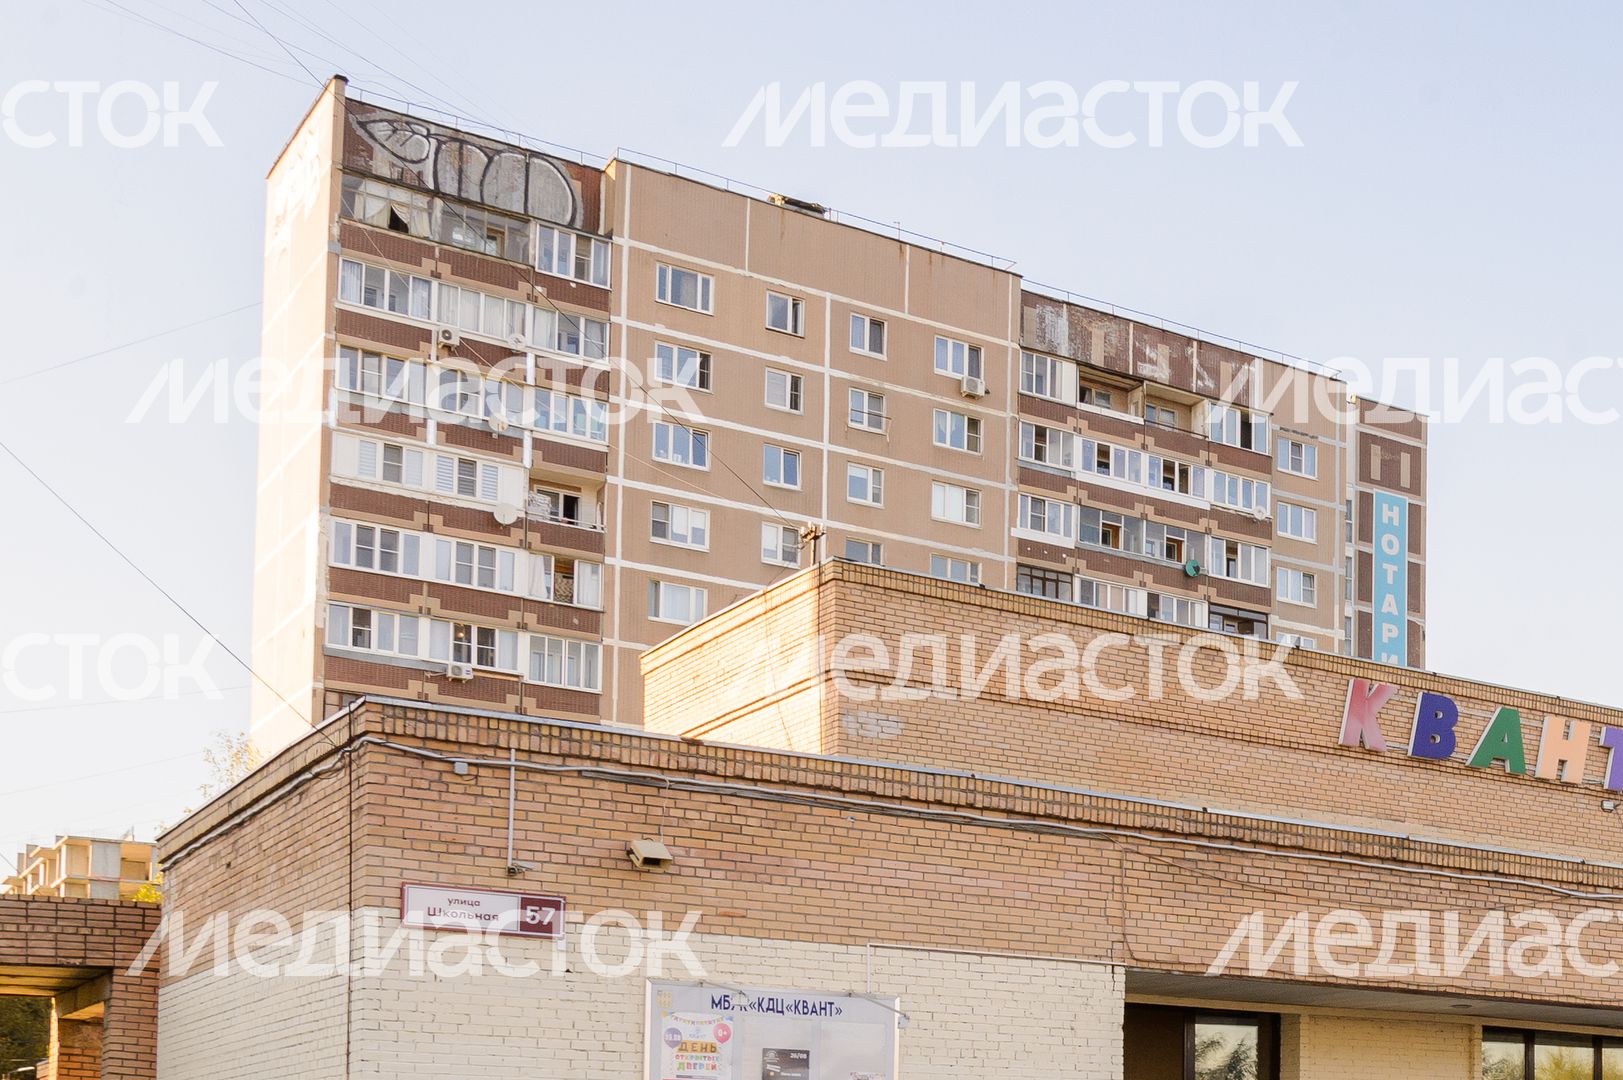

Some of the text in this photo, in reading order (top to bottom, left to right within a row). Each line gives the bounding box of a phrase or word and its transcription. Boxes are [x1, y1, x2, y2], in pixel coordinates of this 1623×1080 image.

[447, 898, 481, 907] улица
[427, 906, 500, 921] Школьная
[525, 905, 556, 926] 57
[711, 994, 748, 1011] МБ
[678, 1042, 717, 1053] ДЕНЬ
